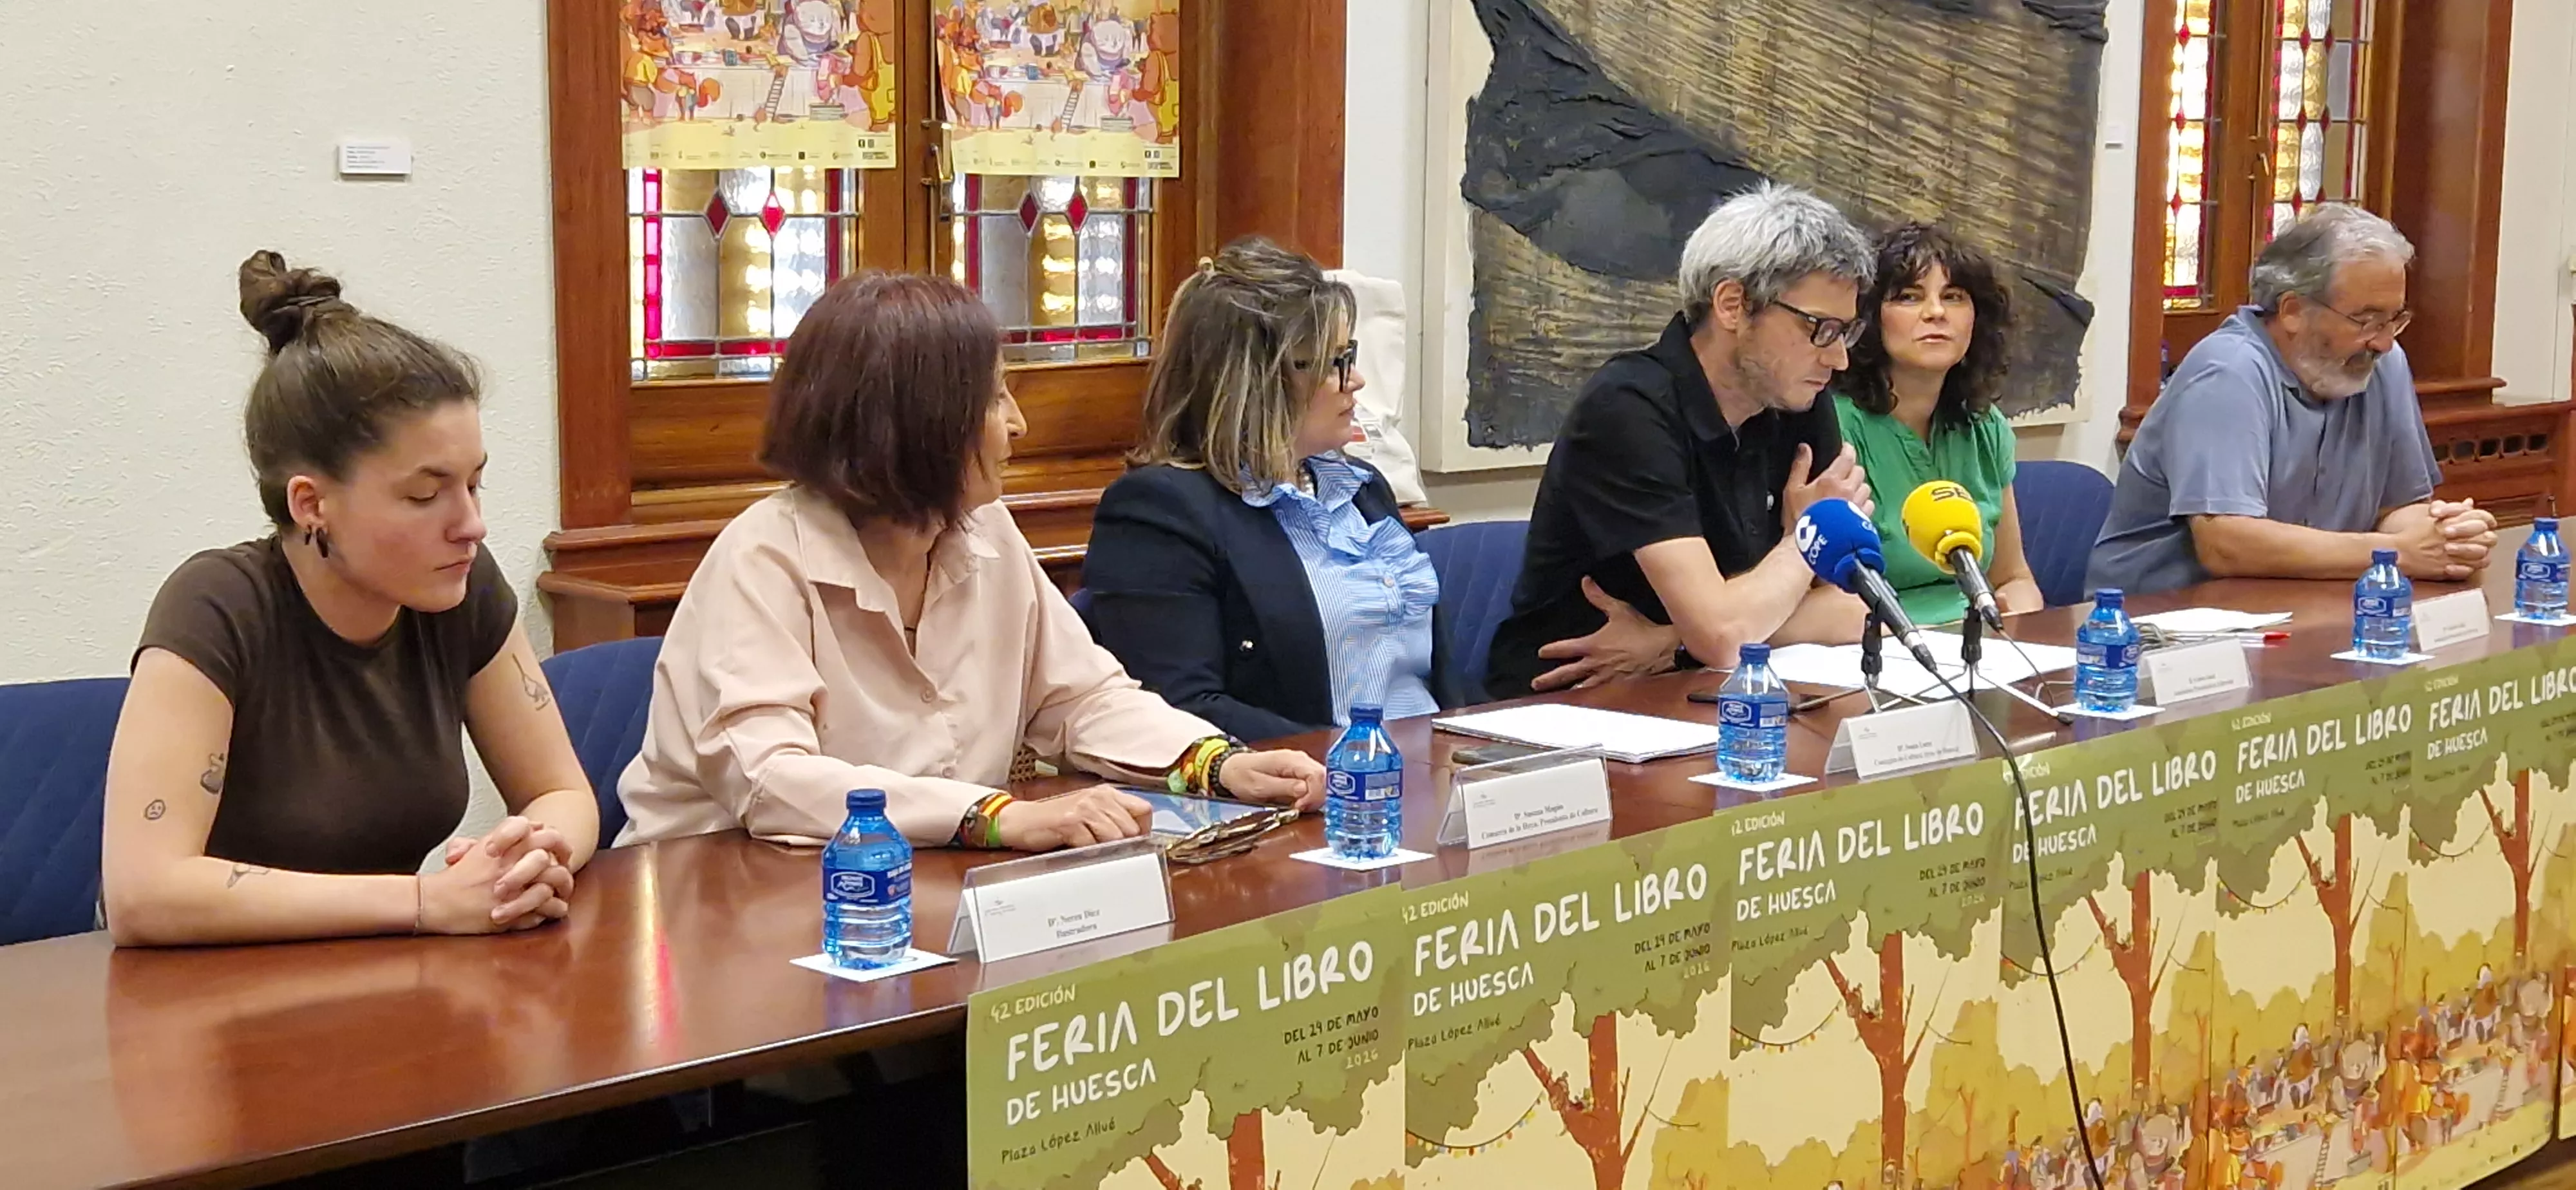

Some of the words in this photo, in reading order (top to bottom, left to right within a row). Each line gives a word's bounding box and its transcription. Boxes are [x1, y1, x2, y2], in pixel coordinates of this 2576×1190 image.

[1808, 534, 1828, 565] COPE
[2429, 688, 2481, 732] FERIA
[2488, 679, 2524, 715] DEL
[2237, 728, 2298, 774] FERIA
[2307, 719, 2347, 755] DEL
[2355, 703, 2411, 745] LIBRO
[2427, 740, 2443, 760] DE
[2444, 726, 2488, 756] HUESCA
[2014, 779, 2087, 831] FERIA
[2097, 767, 2143, 809] DEL
[2152, 750, 2216, 797] LIBRO
[2236, 782, 2253, 804] DE
[2256, 768, 2306, 798] HUESCA
[1739, 829, 1826, 886] FERIA
[1838, 818, 1891, 864] DEL
[1904, 802, 1984, 851] LIBRO
[2038, 823, 2098, 857] HUESCA
[1421, 890, 1469, 918] EDICIÓN
[1736, 895, 1762, 921] DE
[1768, 878, 1836, 916] HUESCA
[1415, 908, 1520, 977] FERIA
[1534, 891, 1600, 943] DEL
[1615, 863, 1707, 923] LIBRO
[1634, 940, 1652, 955] DEL
[1669, 932, 1681, 945] DE
[1644, 959, 1656, 973] AL
[990, 1001, 1011, 1023] 42
[1014, 983, 1076, 1015] EDICIÓN
[1414, 987, 1442, 1017] DE
[1450, 961, 1534, 1008] HUESCA
[1007, 1001, 1138, 1082] FERIA
[1159, 977, 1239, 1037] DEL
[1258, 940, 1374, 1011] LIBRO
[1283, 1028, 1306, 1045] DEL
[1327, 1016, 1341, 1031] DE
[1346, 1005, 1379, 1026] MAYO
[1297, 1050, 1312, 1065] AL
[1316, 1043, 1323, 1058] 7
[1329, 1039, 1343, 1053] DE
[1348, 1028, 1379, 1050] JUNIO
[1441, 1024, 1473, 1042] López
[1007, 1090, 1042, 1126] DE
[1052, 1057, 1157, 1113] HUESCA
[1001, 1146, 1037, 1164] Plaza
[1041, 1132, 1081, 1151] López
[1086, 1117, 1116, 1138] Allué
